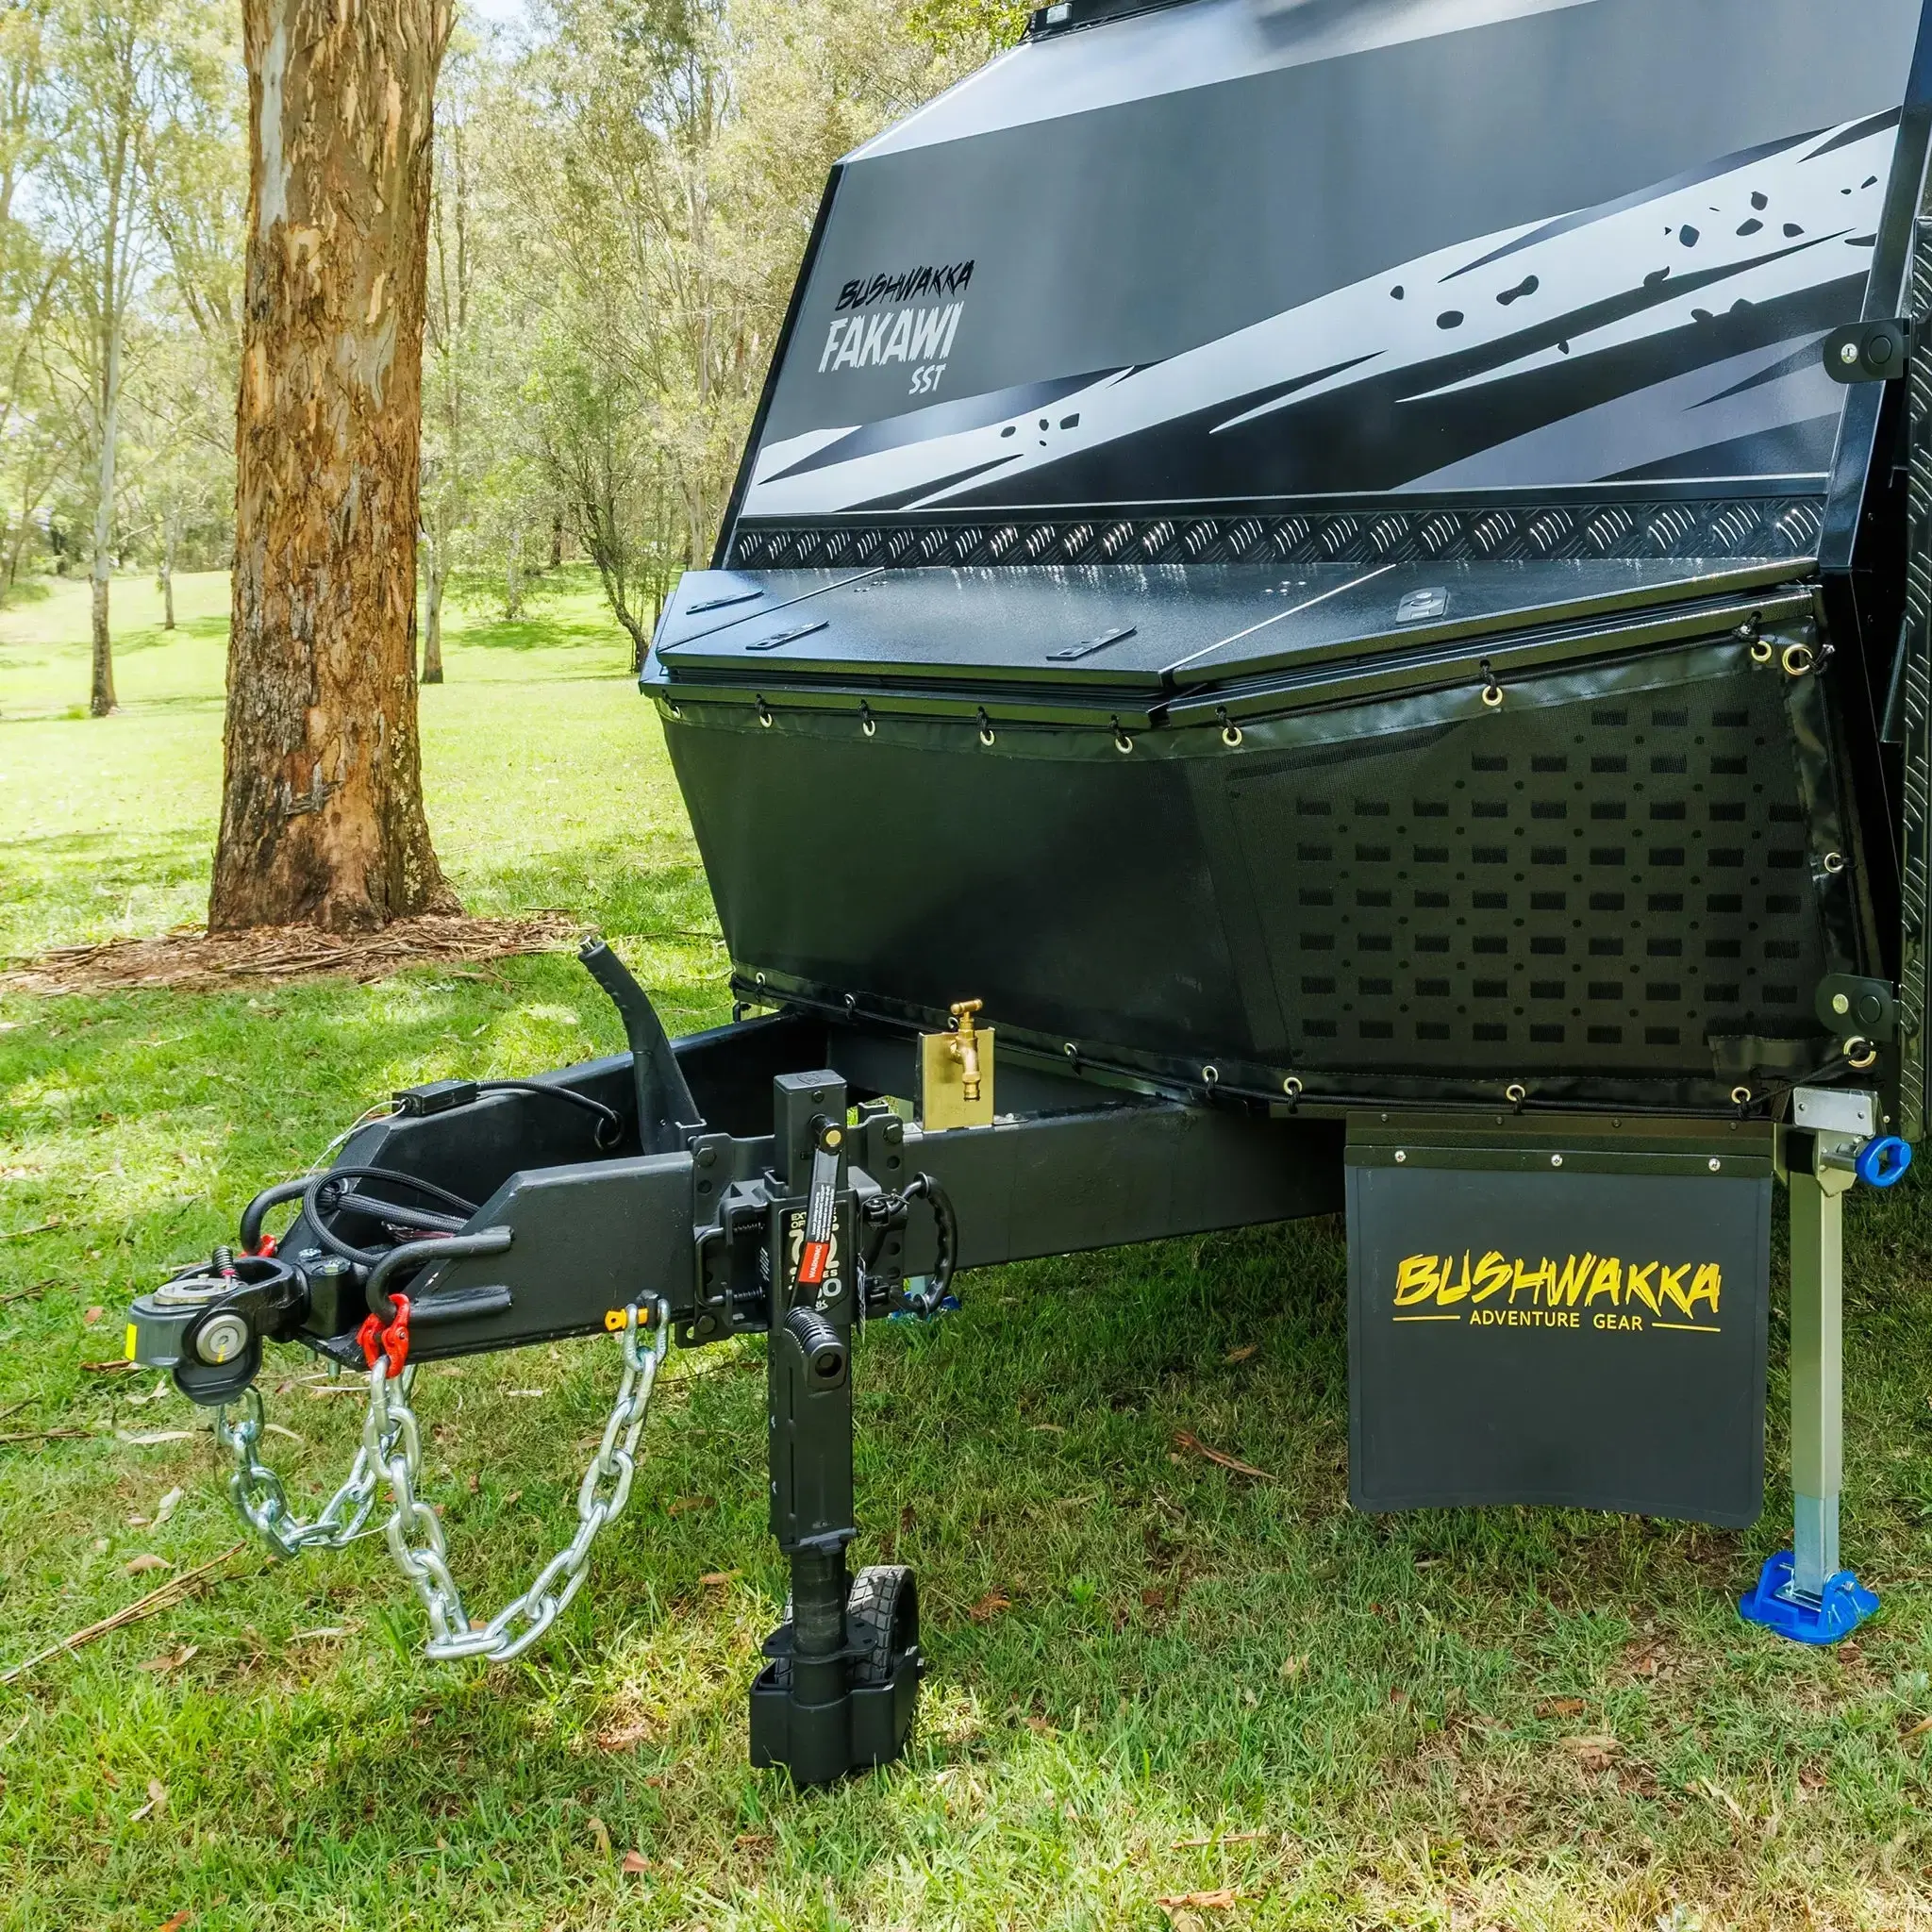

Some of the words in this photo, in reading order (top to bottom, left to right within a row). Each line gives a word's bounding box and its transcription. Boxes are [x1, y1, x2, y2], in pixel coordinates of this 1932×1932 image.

[835, 259, 974, 311] BUSHWAKKA
[818, 300, 964, 373] FAKAWI
[908, 363, 946, 394] SST
[808, 1244, 823, 1278] WARNING
[1393, 1249, 1721, 1319] BUSHWAKKA
[1469, 1309, 1580, 1328] ADVENTURE
[1592, 1313, 1643, 1331] GEAR
